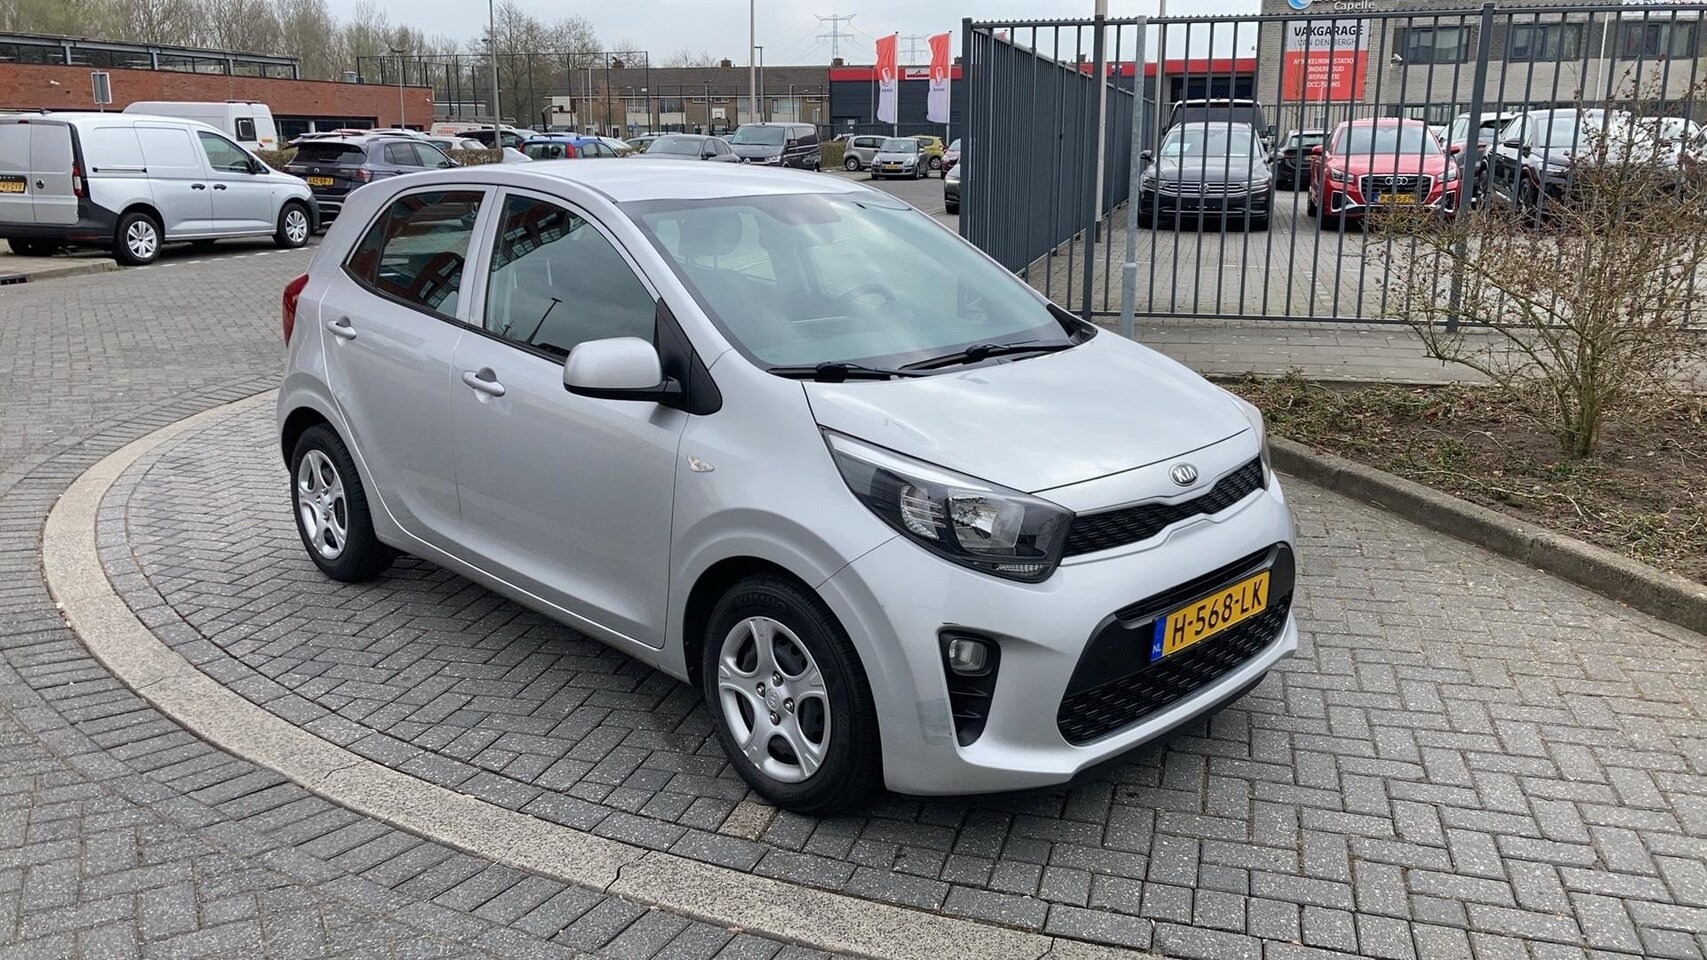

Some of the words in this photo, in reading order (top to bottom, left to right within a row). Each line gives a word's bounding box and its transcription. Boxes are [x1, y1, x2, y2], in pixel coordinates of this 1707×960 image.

[1334, 0, 1375, 11] Capelle
[1294, 25, 1364, 37] VAKGARAGE
[1315, 38, 1330, 46] DEN
[1173, 465, 1198, 483] KIA
[1172, 579, 1263, 647] H-568-LK
[1152, 643, 1162, 654] NL
